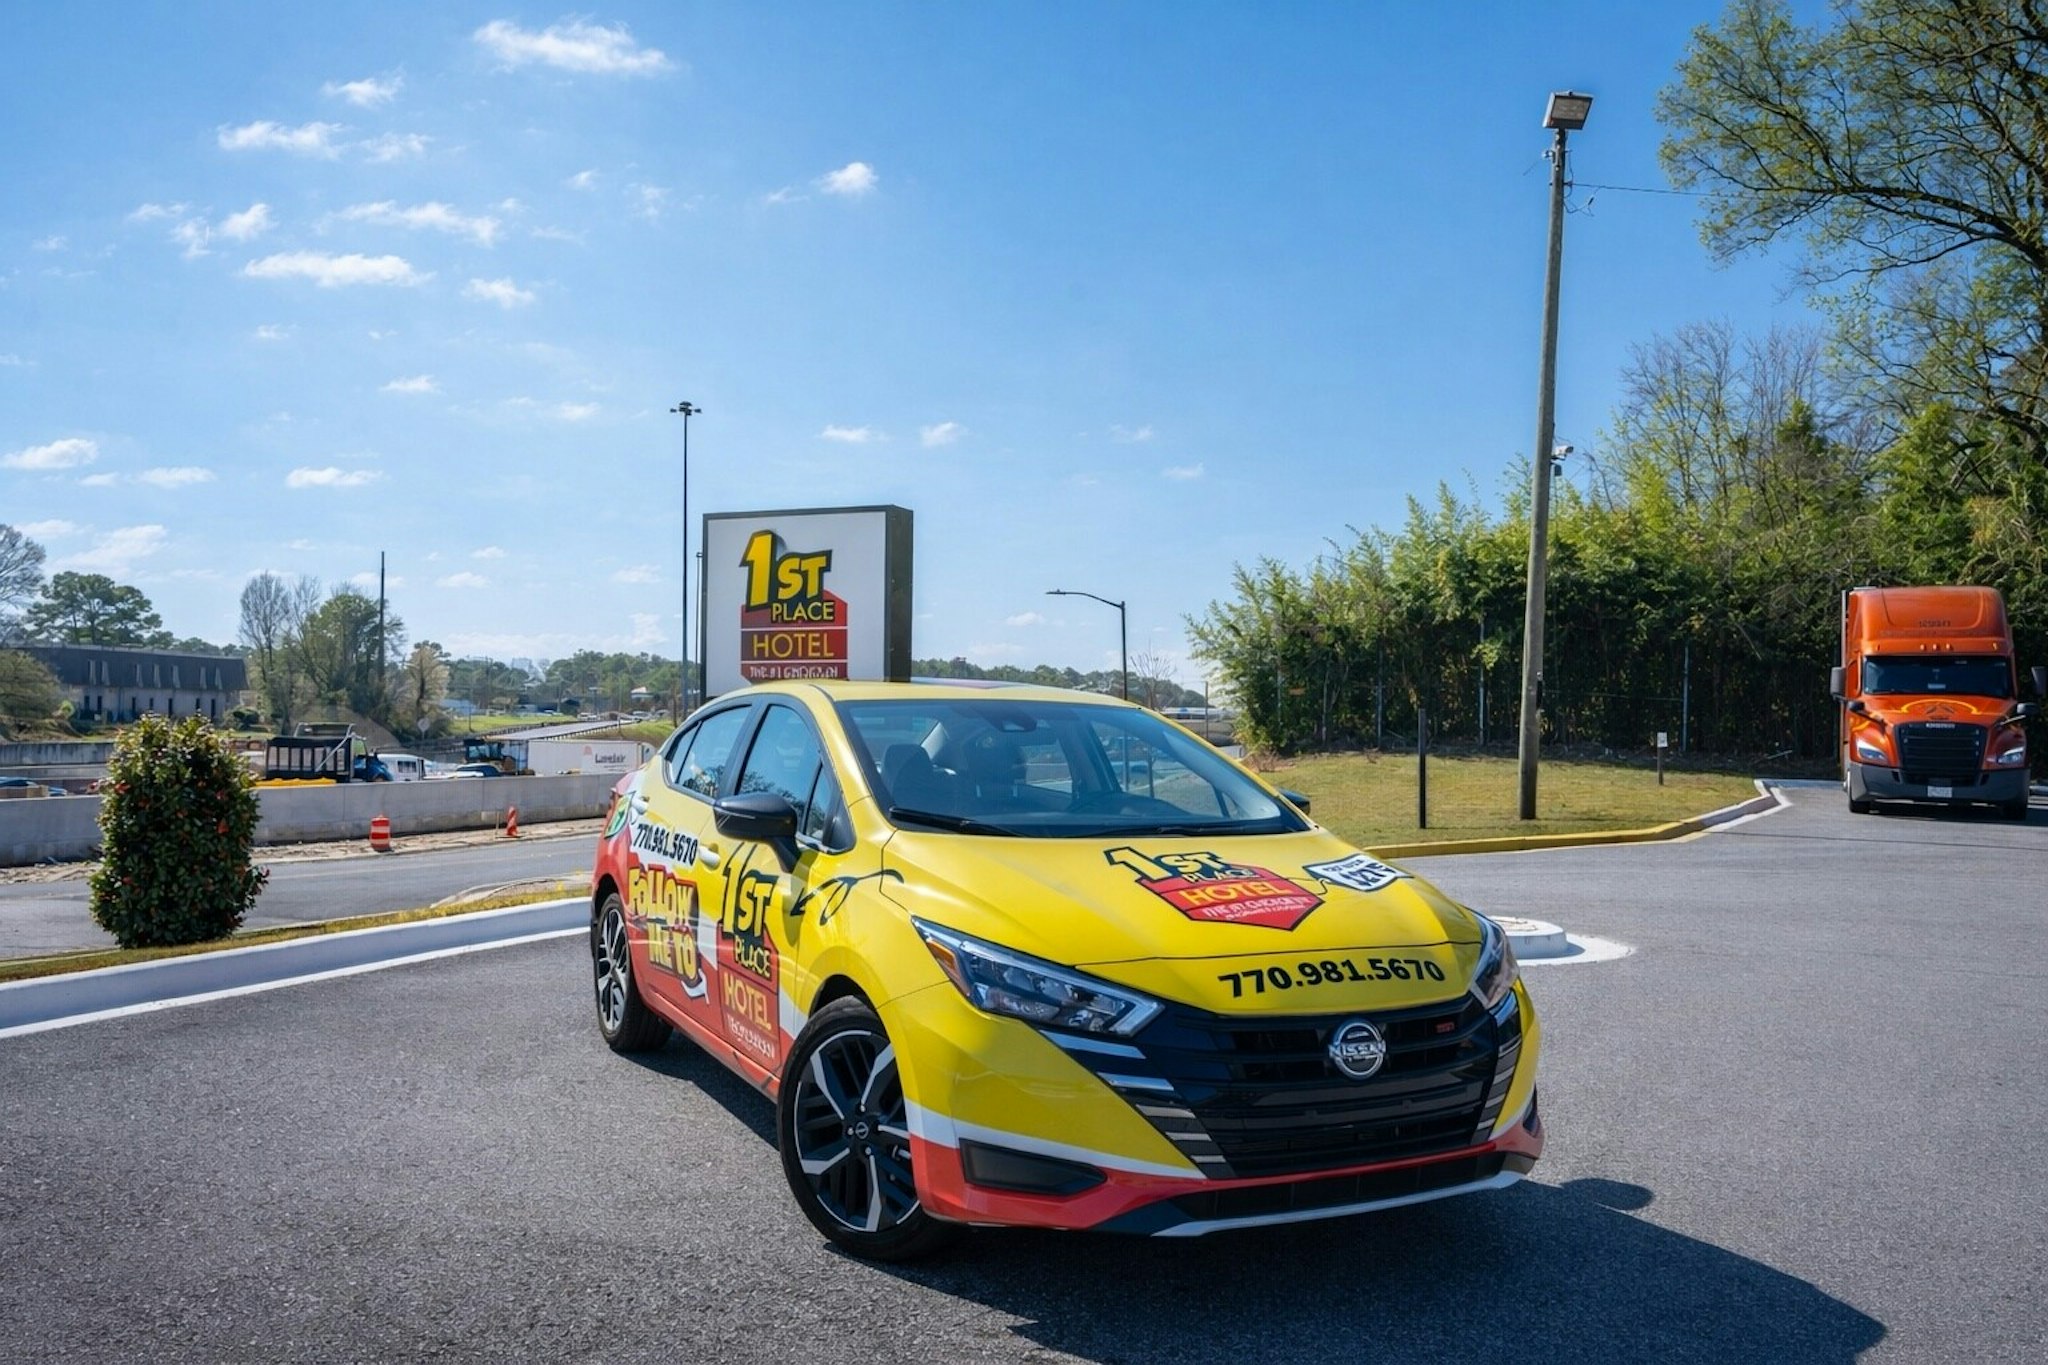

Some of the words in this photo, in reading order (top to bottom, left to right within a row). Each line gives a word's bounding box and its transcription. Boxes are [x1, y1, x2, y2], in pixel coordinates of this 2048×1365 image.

[772, 601, 835, 622] PLACE
[752, 632, 835, 658] HOTEL
[628, 867, 695, 927] FOLLOW
[1178, 881, 1294, 907] HOTEL
[1217, 958, 1446, 998] 770.981.5670
[723, 971, 772, 1031] HOTEL
